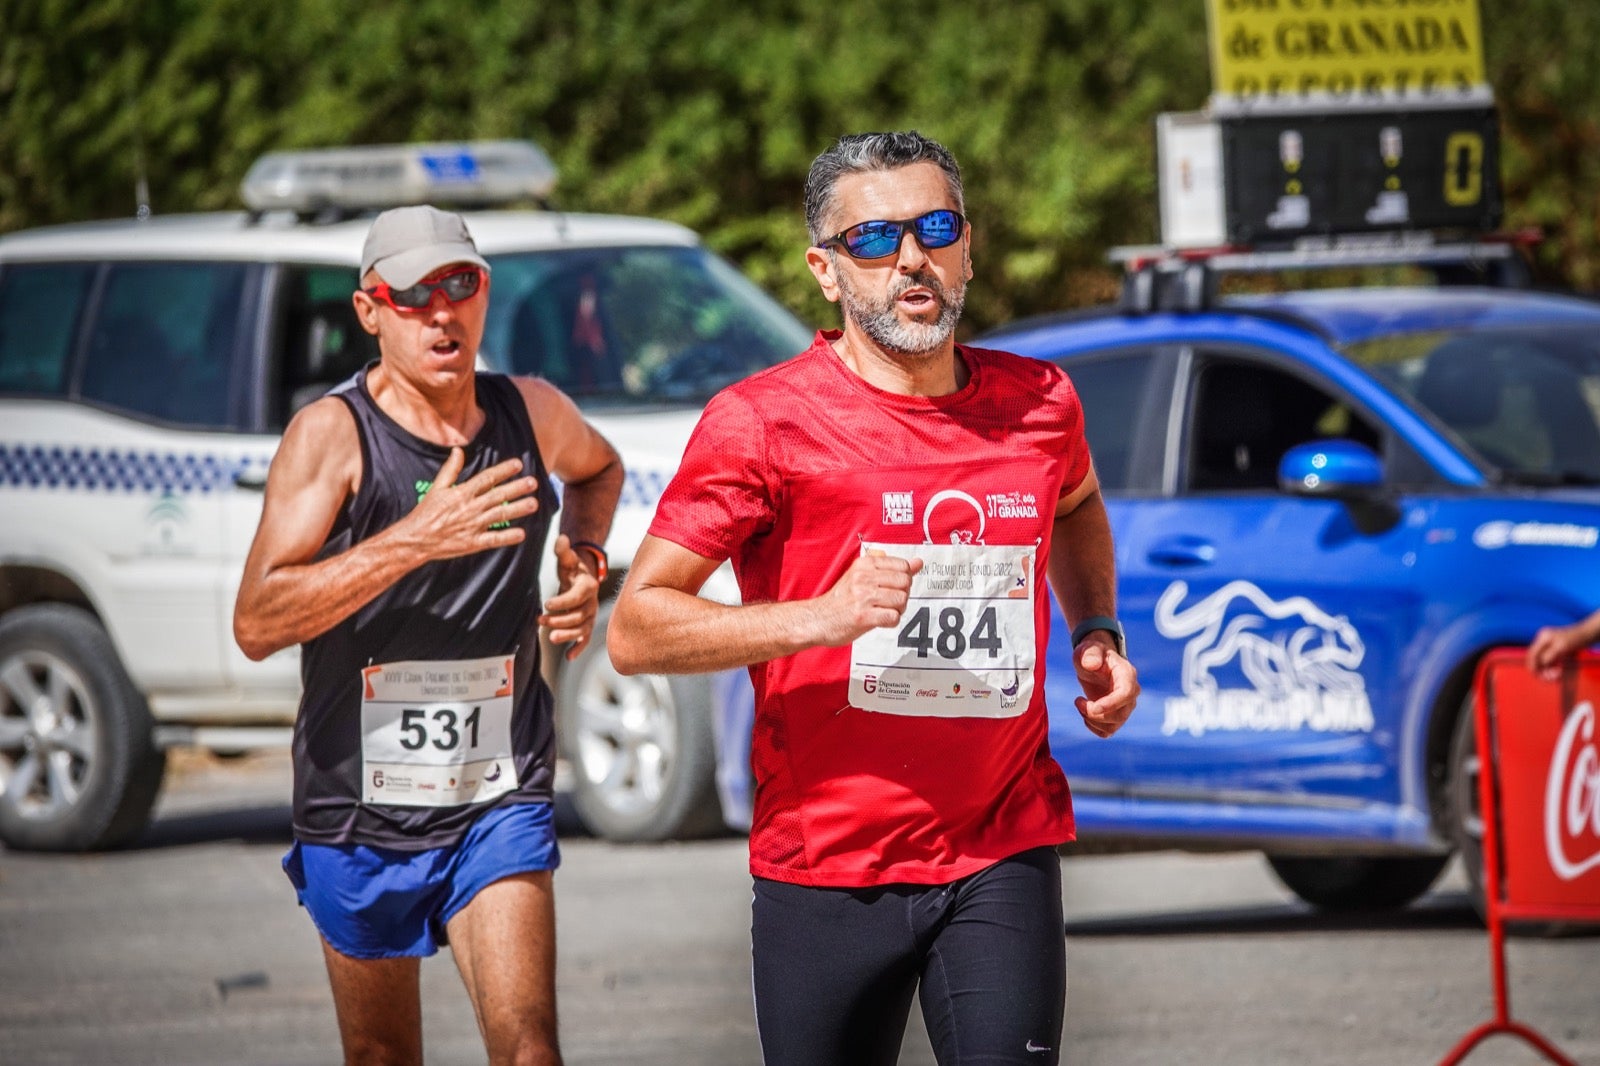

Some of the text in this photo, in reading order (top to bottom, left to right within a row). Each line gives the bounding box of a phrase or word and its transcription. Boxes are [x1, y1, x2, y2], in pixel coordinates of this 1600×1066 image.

[1225, 17, 1471, 61] de GRANADA
[998, 506, 1039, 518] GRANADA
[993, 562, 1013, 577] 2022
[897, 606, 1003, 660] 484
[878, 680, 911, 689] Diputación
[885, 687, 911, 695] Granada
[399, 706, 481, 751] 531
